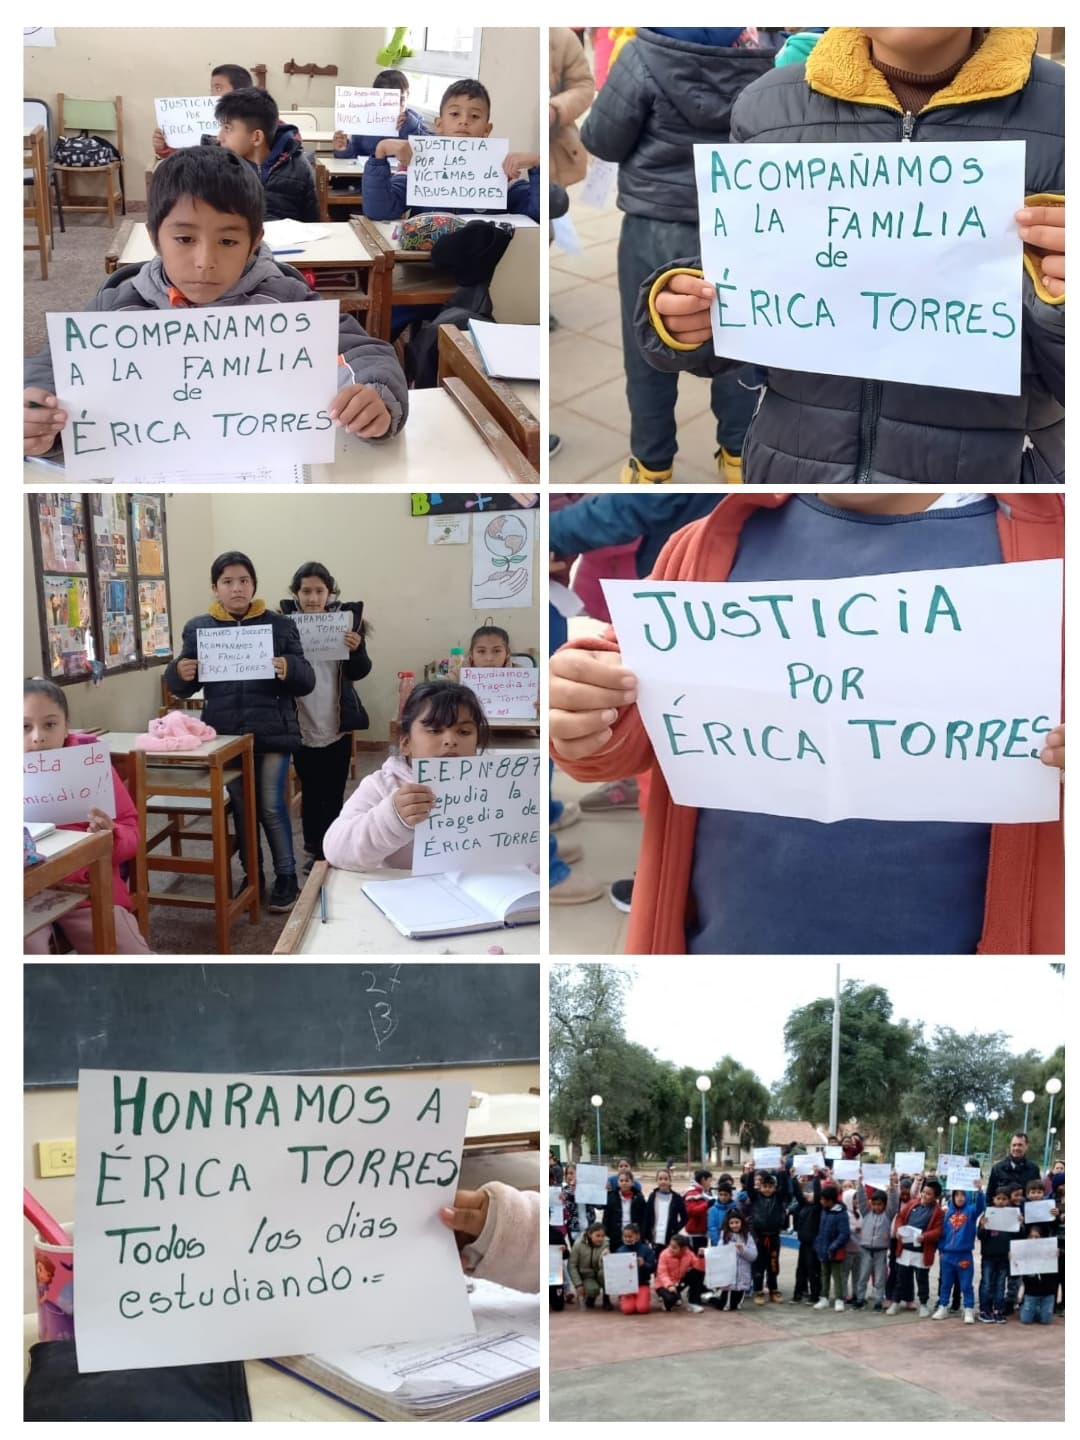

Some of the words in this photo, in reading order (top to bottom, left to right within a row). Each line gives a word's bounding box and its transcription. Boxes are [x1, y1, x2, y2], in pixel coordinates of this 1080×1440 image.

[160, 99, 214, 112] JUSTICIA
[414, 138, 488, 152] JUSTICIA
[415, 155, 435, 167] POR
[444, 155, 467, 166] LAS
[484, 165, 499, 179] de
[710, 150, 984, 193] ACOMPAÑAMOS
[414, 185, 504, 198] ABUSADORES
[714, 207, 727, 237] A
[755, 203, 785, 233] LA
[828, 202, 986, 239] FAMILIA
[815, 242, 848, 268] de
[715, 268, 836, 328] ÉRICA
[860, 291, 1016, 339] TORRES
[65, 313, 311, 351] ACOMPAÑAMOS
[70, 362, 85, 386] A
[112, 358, 142, 381] LA
[183, 347, 313, 380] FAMILIA
[173, 383, 202, 401] de
[72, 409, 191, 455] ÉRICA
[213, 410, 333, 437] TORRES
[463, 668, 530, 683] Repudiamos
[787, 662, 864, 703] POR
[662, 694, 826, 765] ÉRICA
[83, 746, 104, 766] de
[433, 784, 488, 814] epudia
[508, 781, 521, 800] la
[427, 808, 504, 833] Tragedia
[522, 799, 539, 816] de
[424, 837, 482, 857] ÉRICA
[113, 1075, 390, 1135] HONRAMOS
[416, 1088, 441, 1123] A
[95, 1144, 252, 1206] ÉRICA
[288, 1145, 459, 1189] TORRES
[105, 1224, 205, 1264] Todos
[249, 1216, 302, 1254] los
